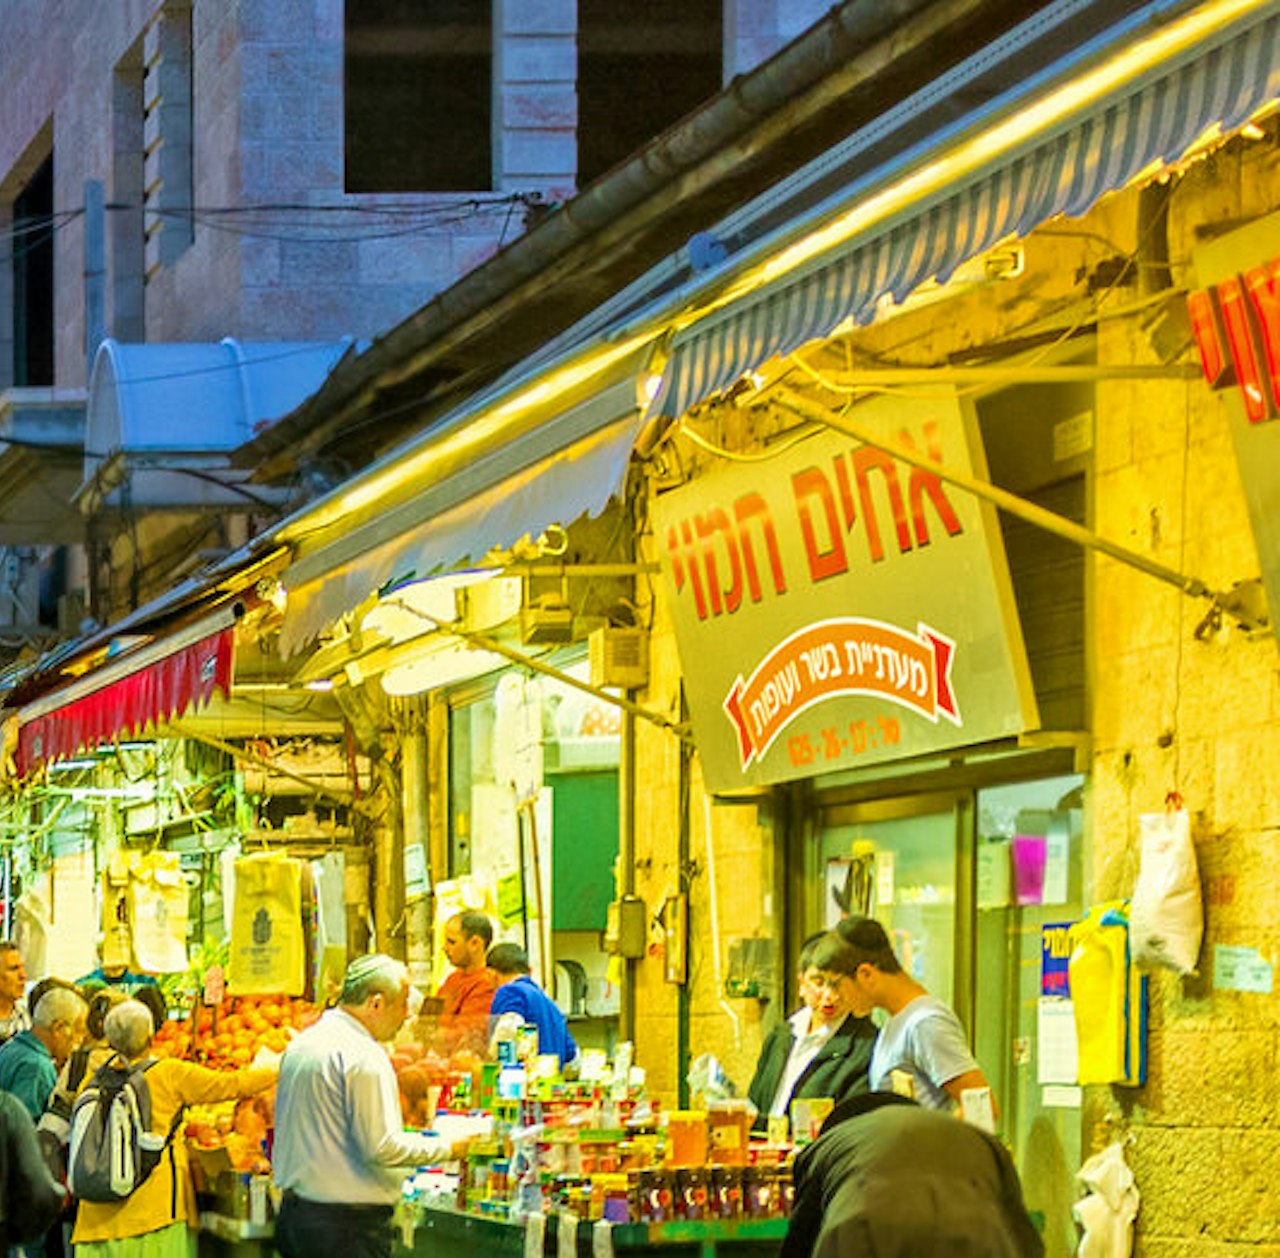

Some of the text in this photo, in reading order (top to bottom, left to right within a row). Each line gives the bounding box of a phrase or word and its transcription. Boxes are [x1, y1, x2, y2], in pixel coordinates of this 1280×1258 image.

[667, 420, 963, 622] אחים חמוי
[749, 659, 802, 738] ועופות
[799, 642, 843, 684] בשר
